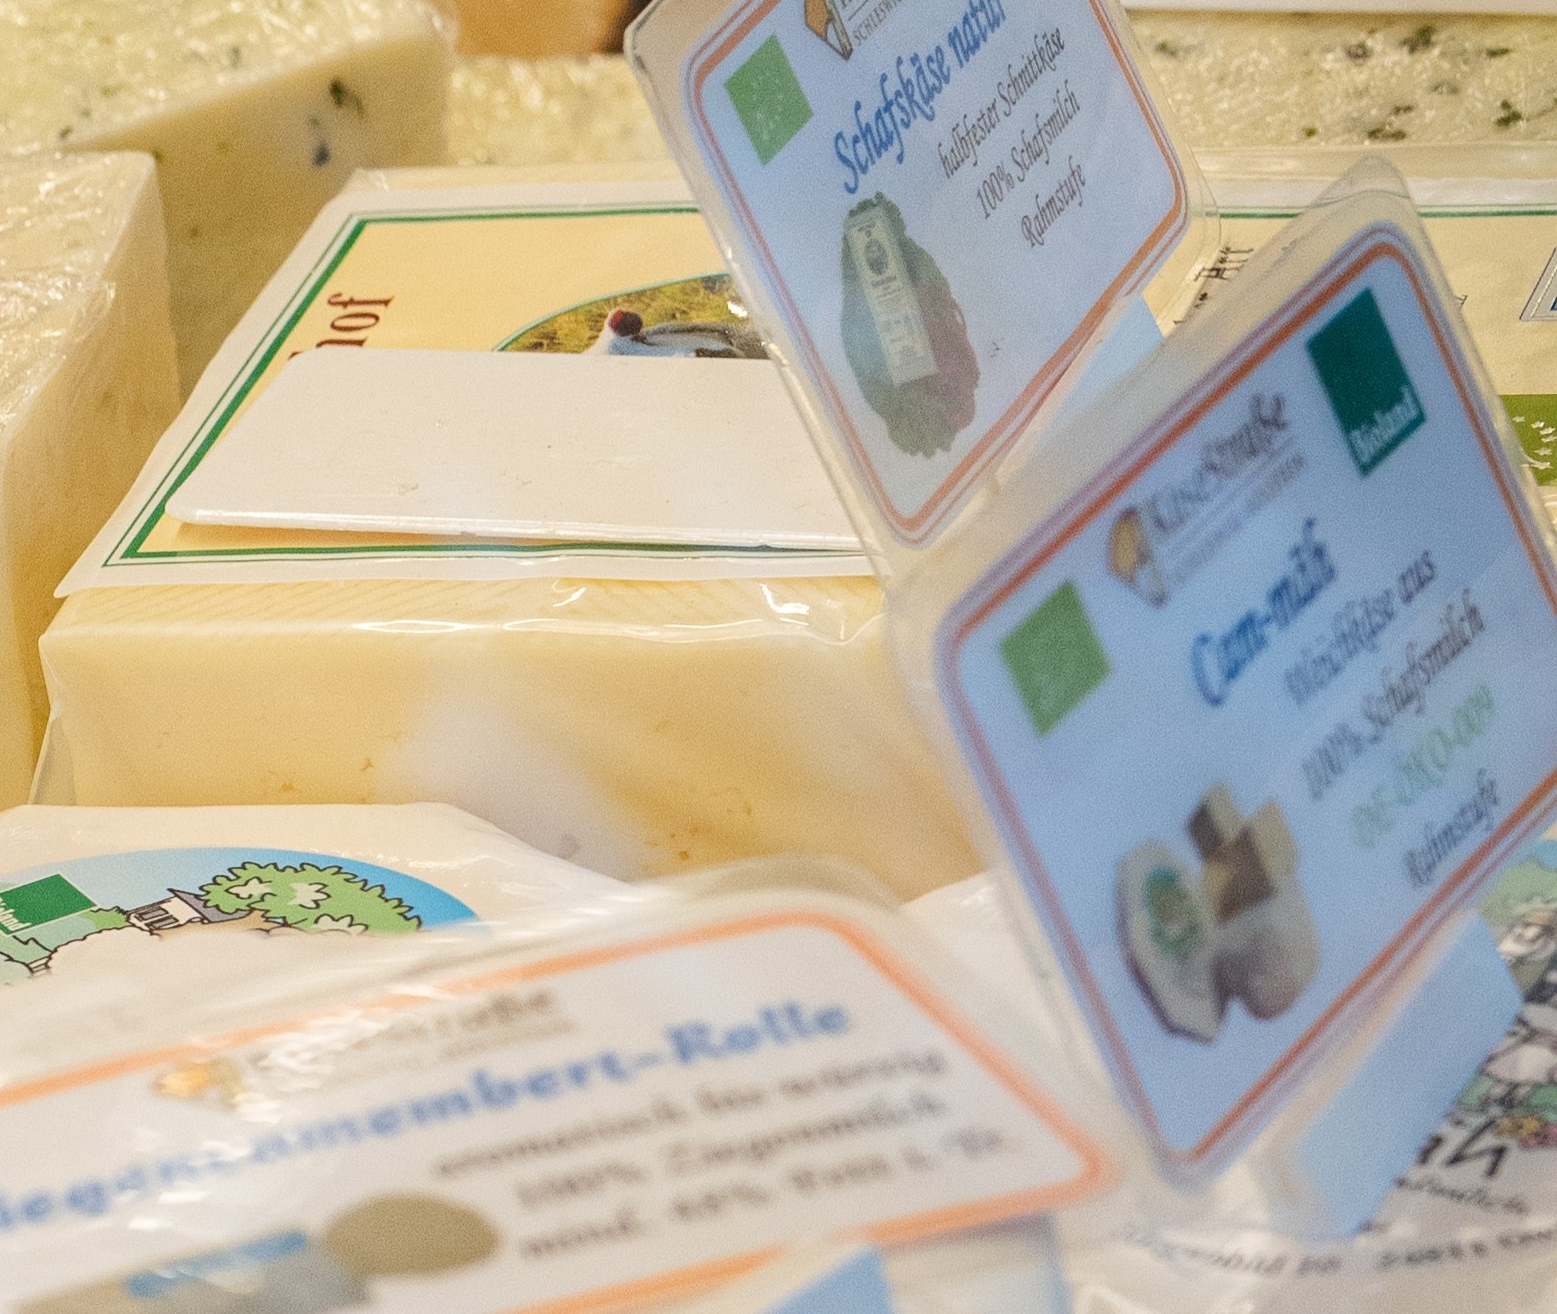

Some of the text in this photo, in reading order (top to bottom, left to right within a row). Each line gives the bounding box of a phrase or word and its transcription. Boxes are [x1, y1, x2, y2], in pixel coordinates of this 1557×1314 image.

[834, 45, 951, 195] Schafskäse
[938, 26, 1065, 180] halbfester Schnittkäse
[975, 78, 1081, 221] 100% Schafsmilch
[1020, 154, 1087, 249] Rahmstufe
